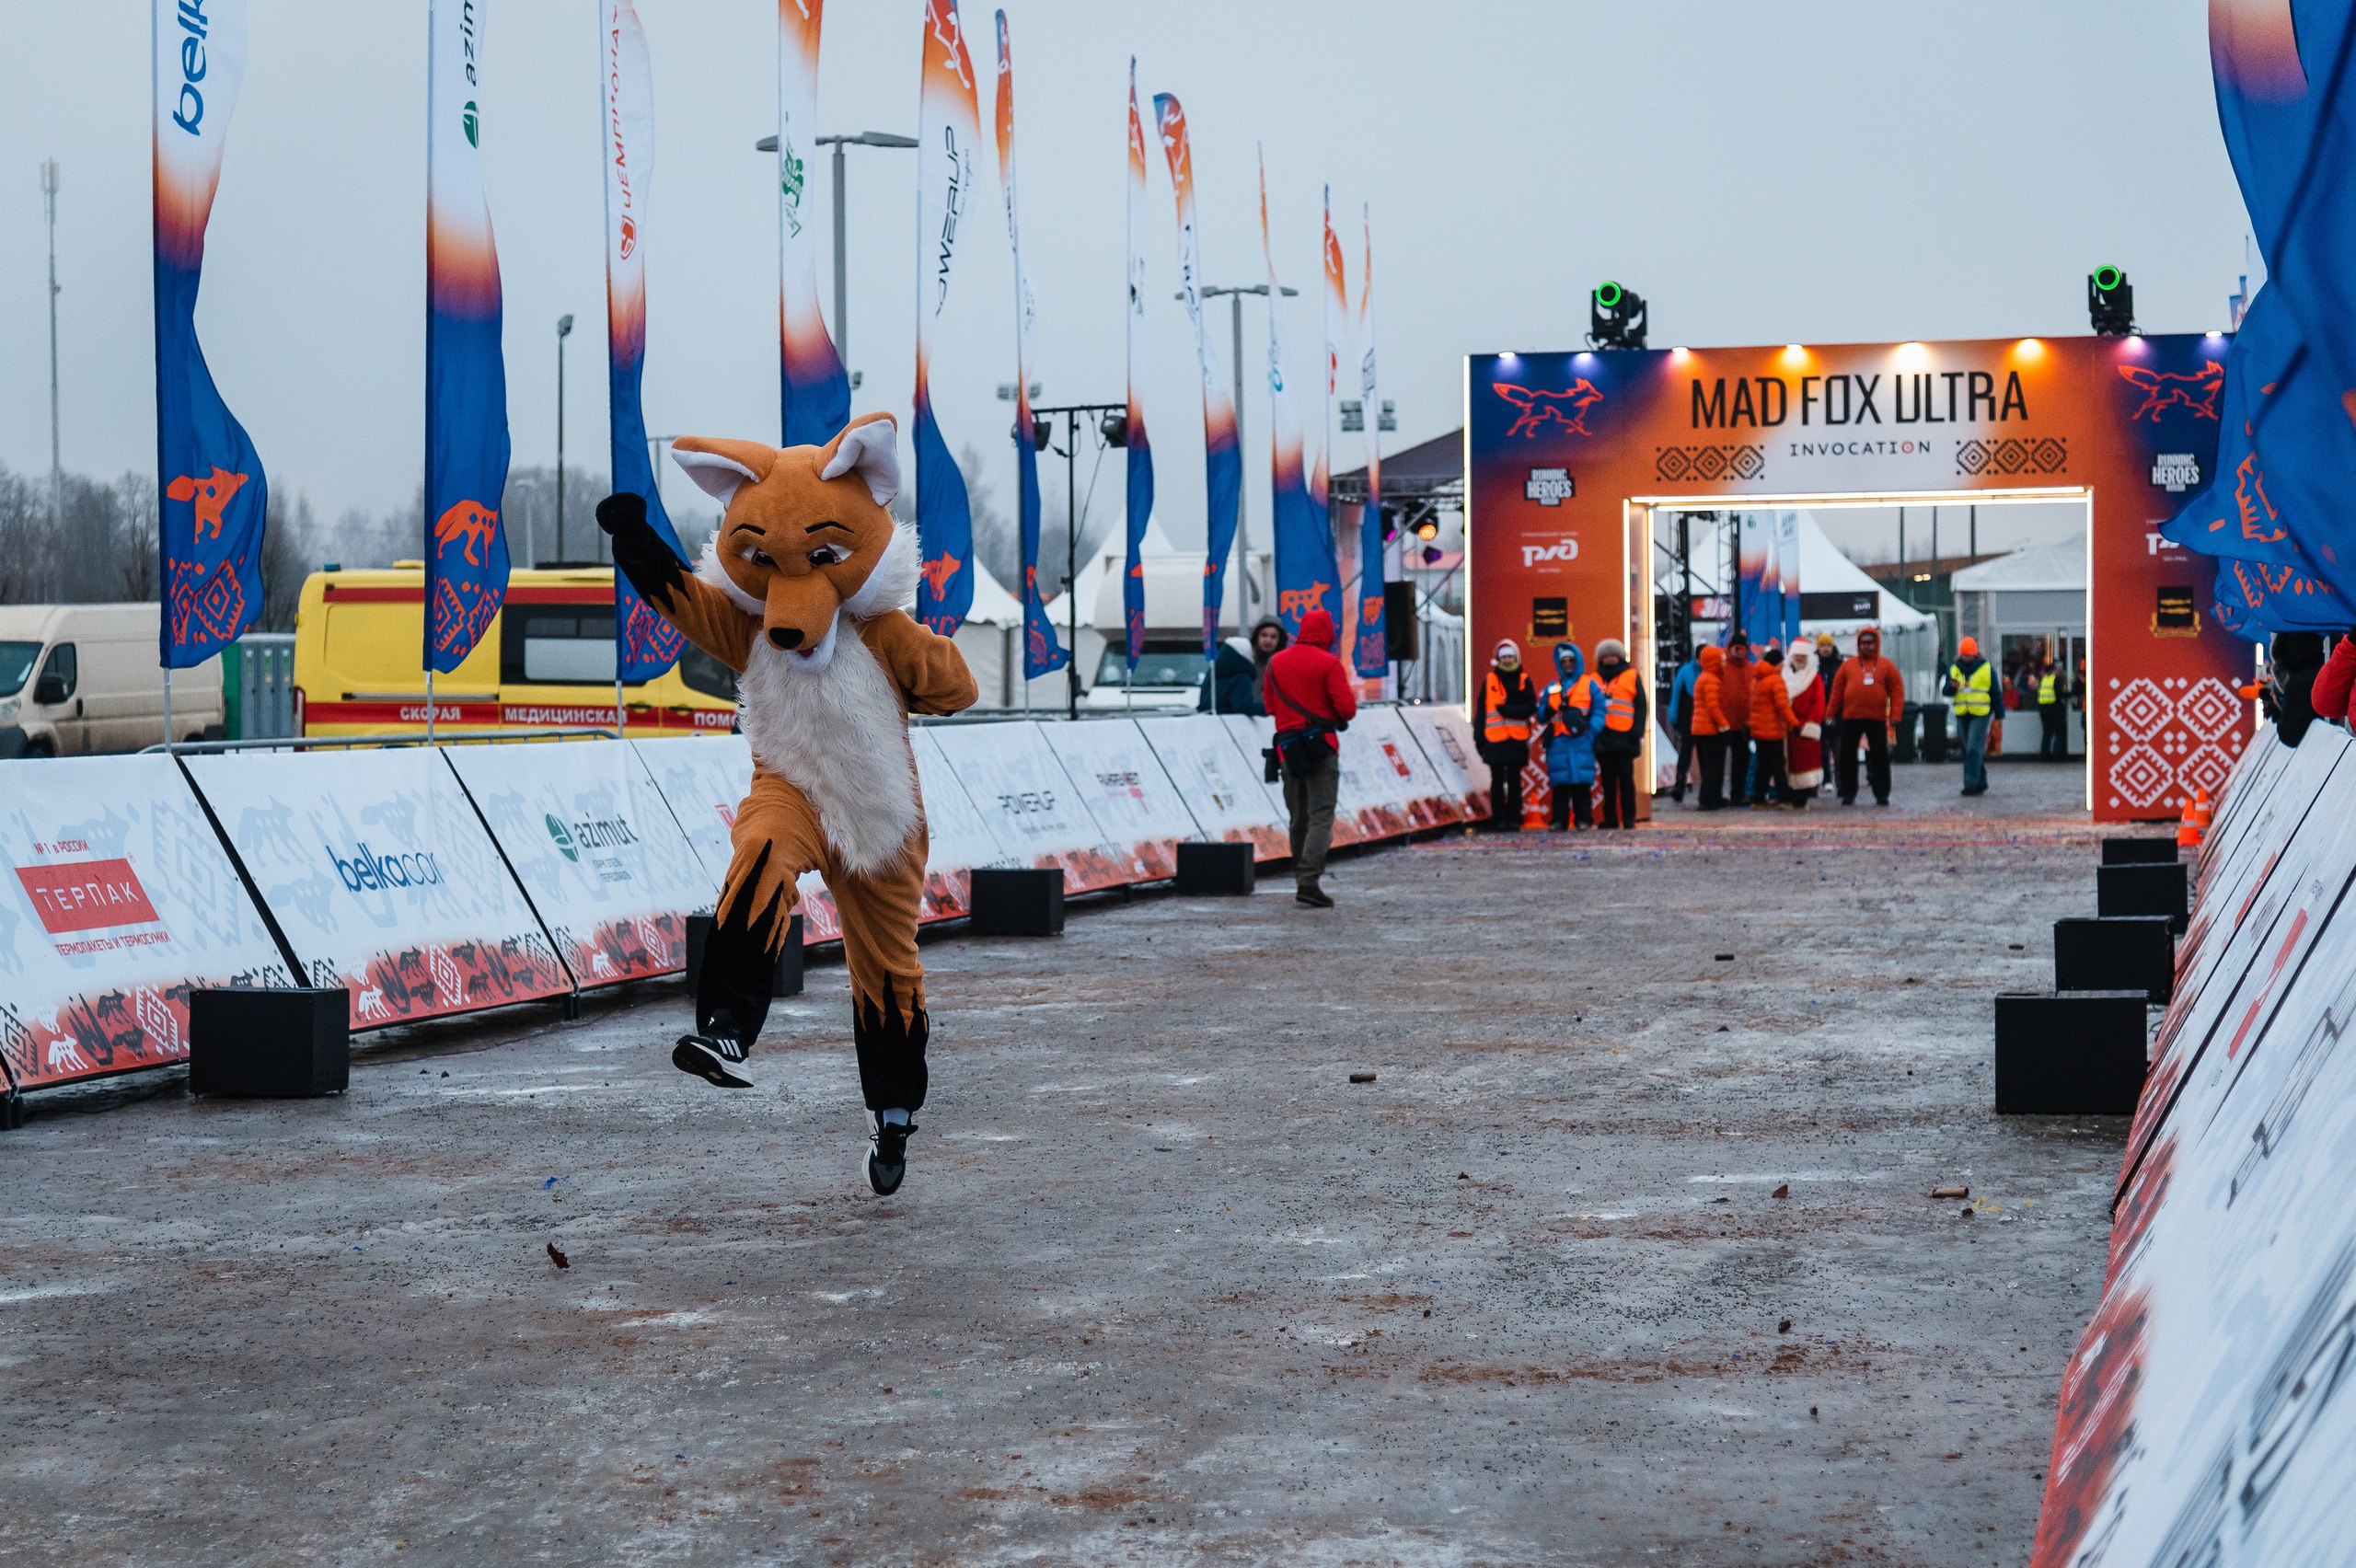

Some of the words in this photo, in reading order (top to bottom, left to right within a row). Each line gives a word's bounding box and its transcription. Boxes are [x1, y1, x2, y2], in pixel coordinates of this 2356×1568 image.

[935, 125, 960, 318] OWERUP
[1692, 377, 1788, 429] MAD
[1801, 374, 1883, 426] FOX
[1896, 371, 2028, 424] ULTRA
[1790, 440, 1931, 457] INVOCATION
[1526, 479, 1573, 500] HEROES
[2152, 466, 2200, 486] HEROES
[399, 706, 461, 721] СКОРАЯ
[573, 812, 639, 849] azimut
[57, 839, 89, 853] РОССИИ
[325, 842, 445, 893] belkacar
[35, 881, 140, 912] ТЕРПАК
[55, 938, 114, 957] ТЕРМОПАКЕТЫ
[112, 937, 121, 949] И
[120, 930, 171, 949] ТЕРМОСУМКИ
